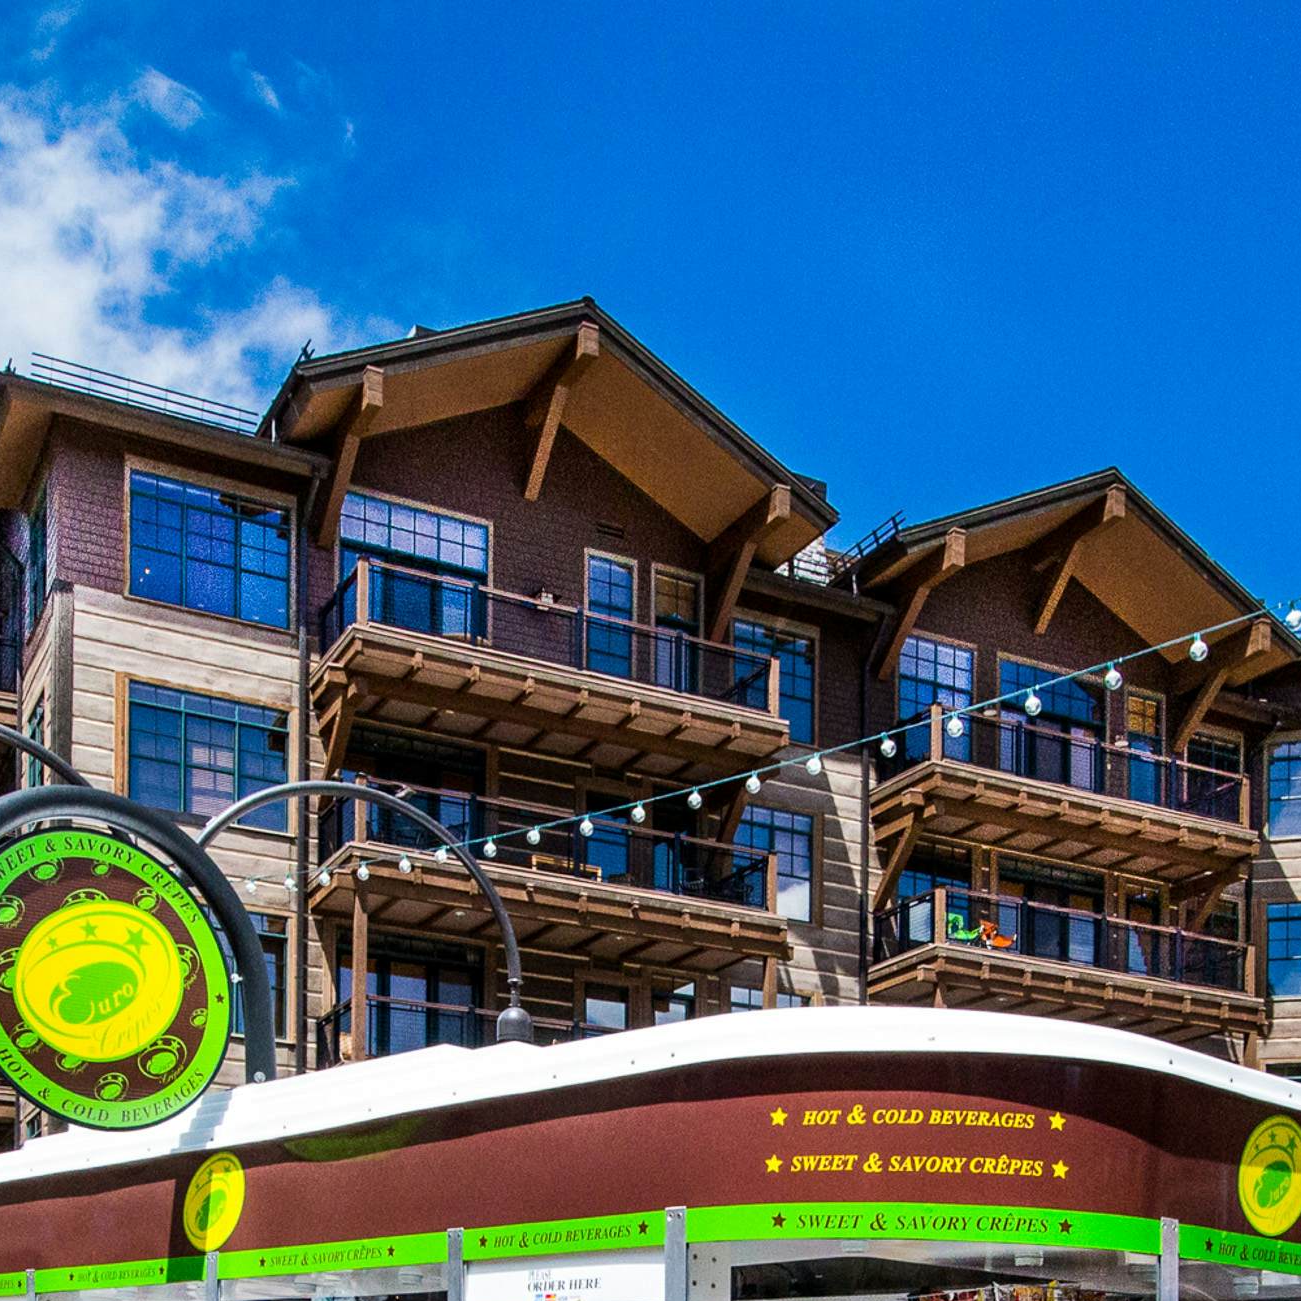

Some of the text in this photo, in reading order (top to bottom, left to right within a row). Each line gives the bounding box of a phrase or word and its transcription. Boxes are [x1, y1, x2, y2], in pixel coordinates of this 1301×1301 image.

[45, 838, 57, 853] &
[64, 837, 134, 863] SAVORY
[141, 862, 201, 924] CRÊPES
[52, 975, 134, 1025] Euro
[38, 1087, 50, 1100] &
[61, 1098, 110, 1122] COLD
[121, 1070, 205, 1123] BEVERAGES
[803, 1105, 1035, 1129] HOT & COLD BEVERAGES
[791, 1153, 1044, 1177] SWEET & SAVORY CRÊPES
[797, 1213, 1049, 1234] SWEET & SAVORY CRÊPES
[494, 1224, 632, 1249] HOT & COLD BEVERAGES
[270, 1245, 383, 1267] SWEET & SAVORY CRÊPES
[1219, 1244, 1236, 1257] HOT
[1239, 1243, 1249, 1261] &
[1252, 1248, 1276, 1262] COLD
[527, 1277, 602, 1292] ORDER HERE
